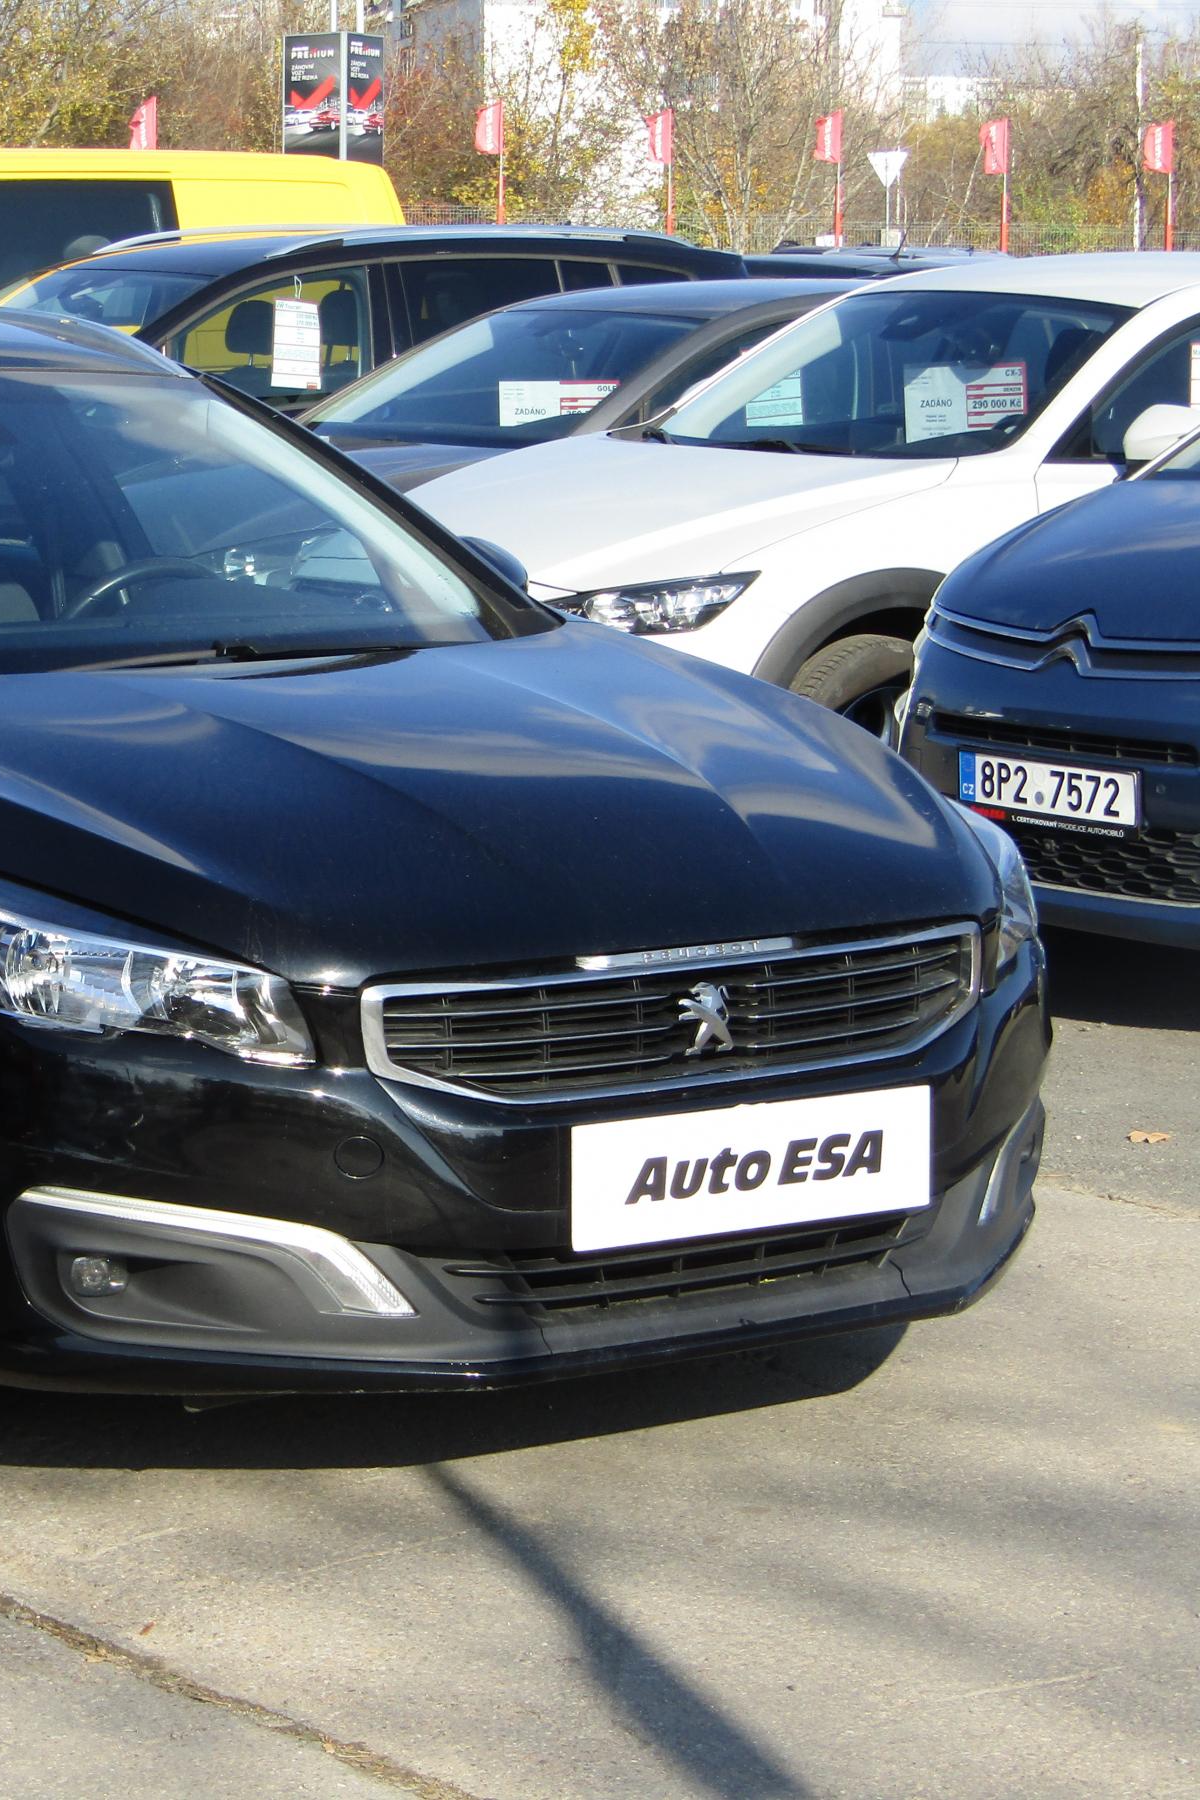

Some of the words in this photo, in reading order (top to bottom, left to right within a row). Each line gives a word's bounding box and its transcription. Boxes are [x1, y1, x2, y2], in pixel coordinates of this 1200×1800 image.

[920, 398, 952, 408] ZADÁNO
[972, 400, 988, 409] 290
[990, 399, 1007, 408] 000
[1009, 398, 1022, 408] Kč
[514, 407, 547, 416] ZADÁNO
[962, 782, 975, 796] CZ
[981, 761, 1028, 804] 8P2
[1050, 770, 1120, 818] 7572
[1057, 821, 1087, 833] PRODEJCE
[1087, 827, 1125, 838] AUTOMOBILŮ
[643, 940, 760, 964] PEUGEOT
[624, 1147, 771, 1205] Auto
[777, 1129, 883, 1186] ESA
